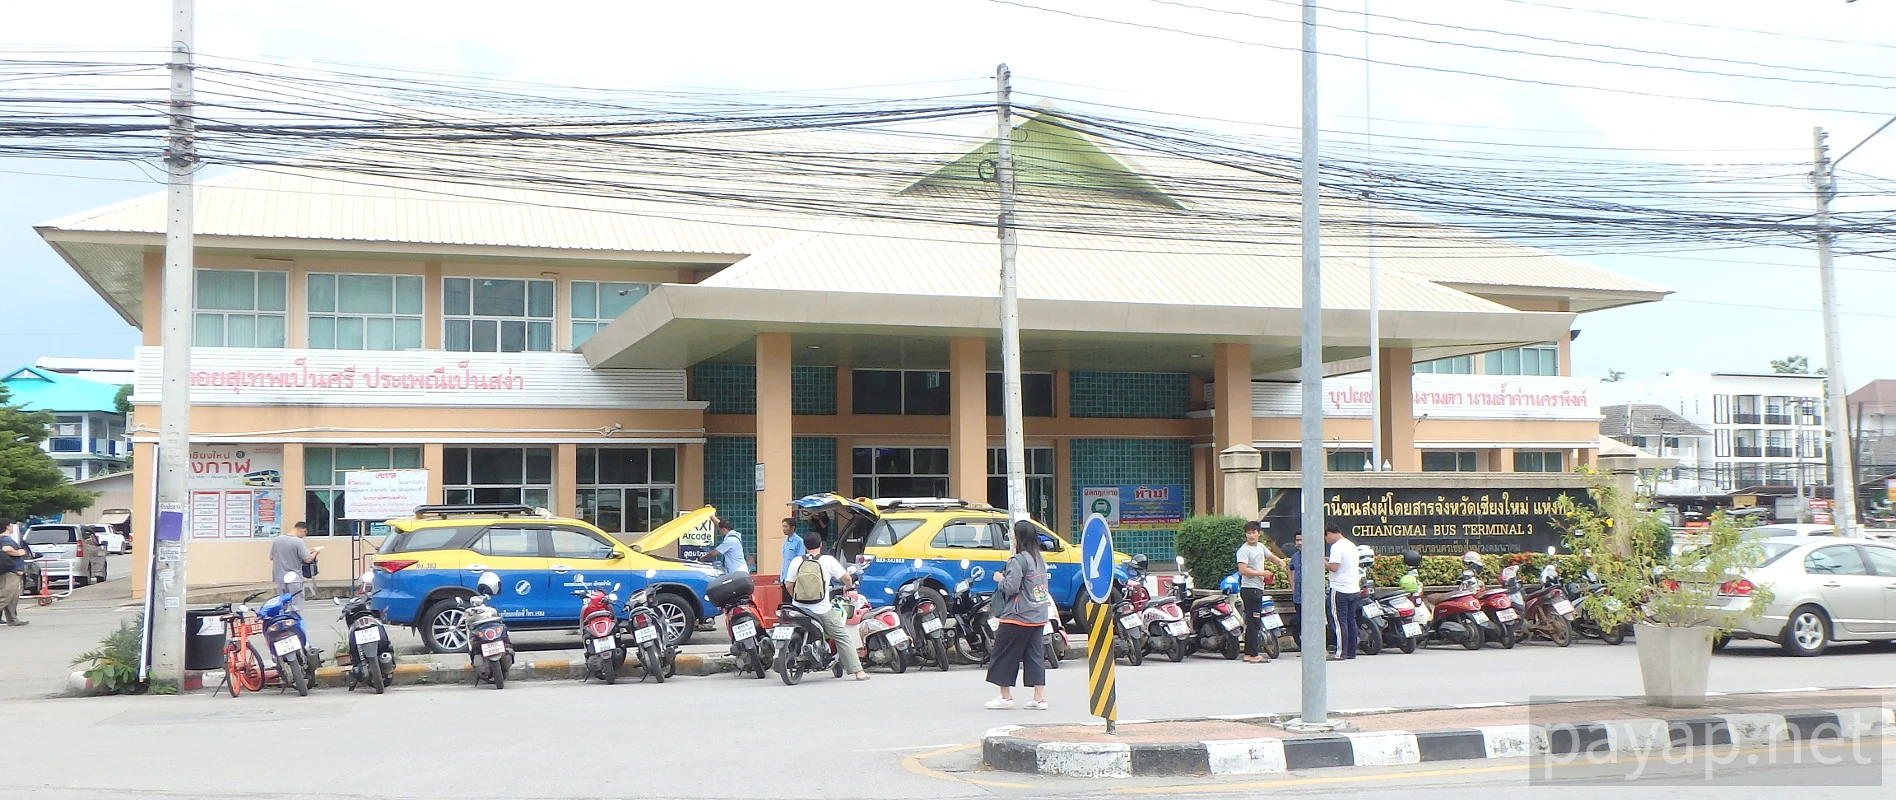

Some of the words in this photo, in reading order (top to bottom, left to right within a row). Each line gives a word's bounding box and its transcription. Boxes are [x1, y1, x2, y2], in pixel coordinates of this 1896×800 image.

[363, 359, 524, 391] ประเพณีเป็นสง่า
[191, 459, 251, 474] งกาฬ
[1323, 491, 1529, 524] านีขนส่งผู้โดยสารจังหวัดเชียงใหม่
[1533, 496, 1566, 516] แห่งท
[695, 519, 711, 531] XI
[1352, 525, 1427, 537] CHIANGMAI
[1433, 524, 1457, 536] BUS
[1462, 524, 1525, 536] TERMINAL
[1527, 524, 1533, 535] 3
[682, 532, 712, 541] Arcade
